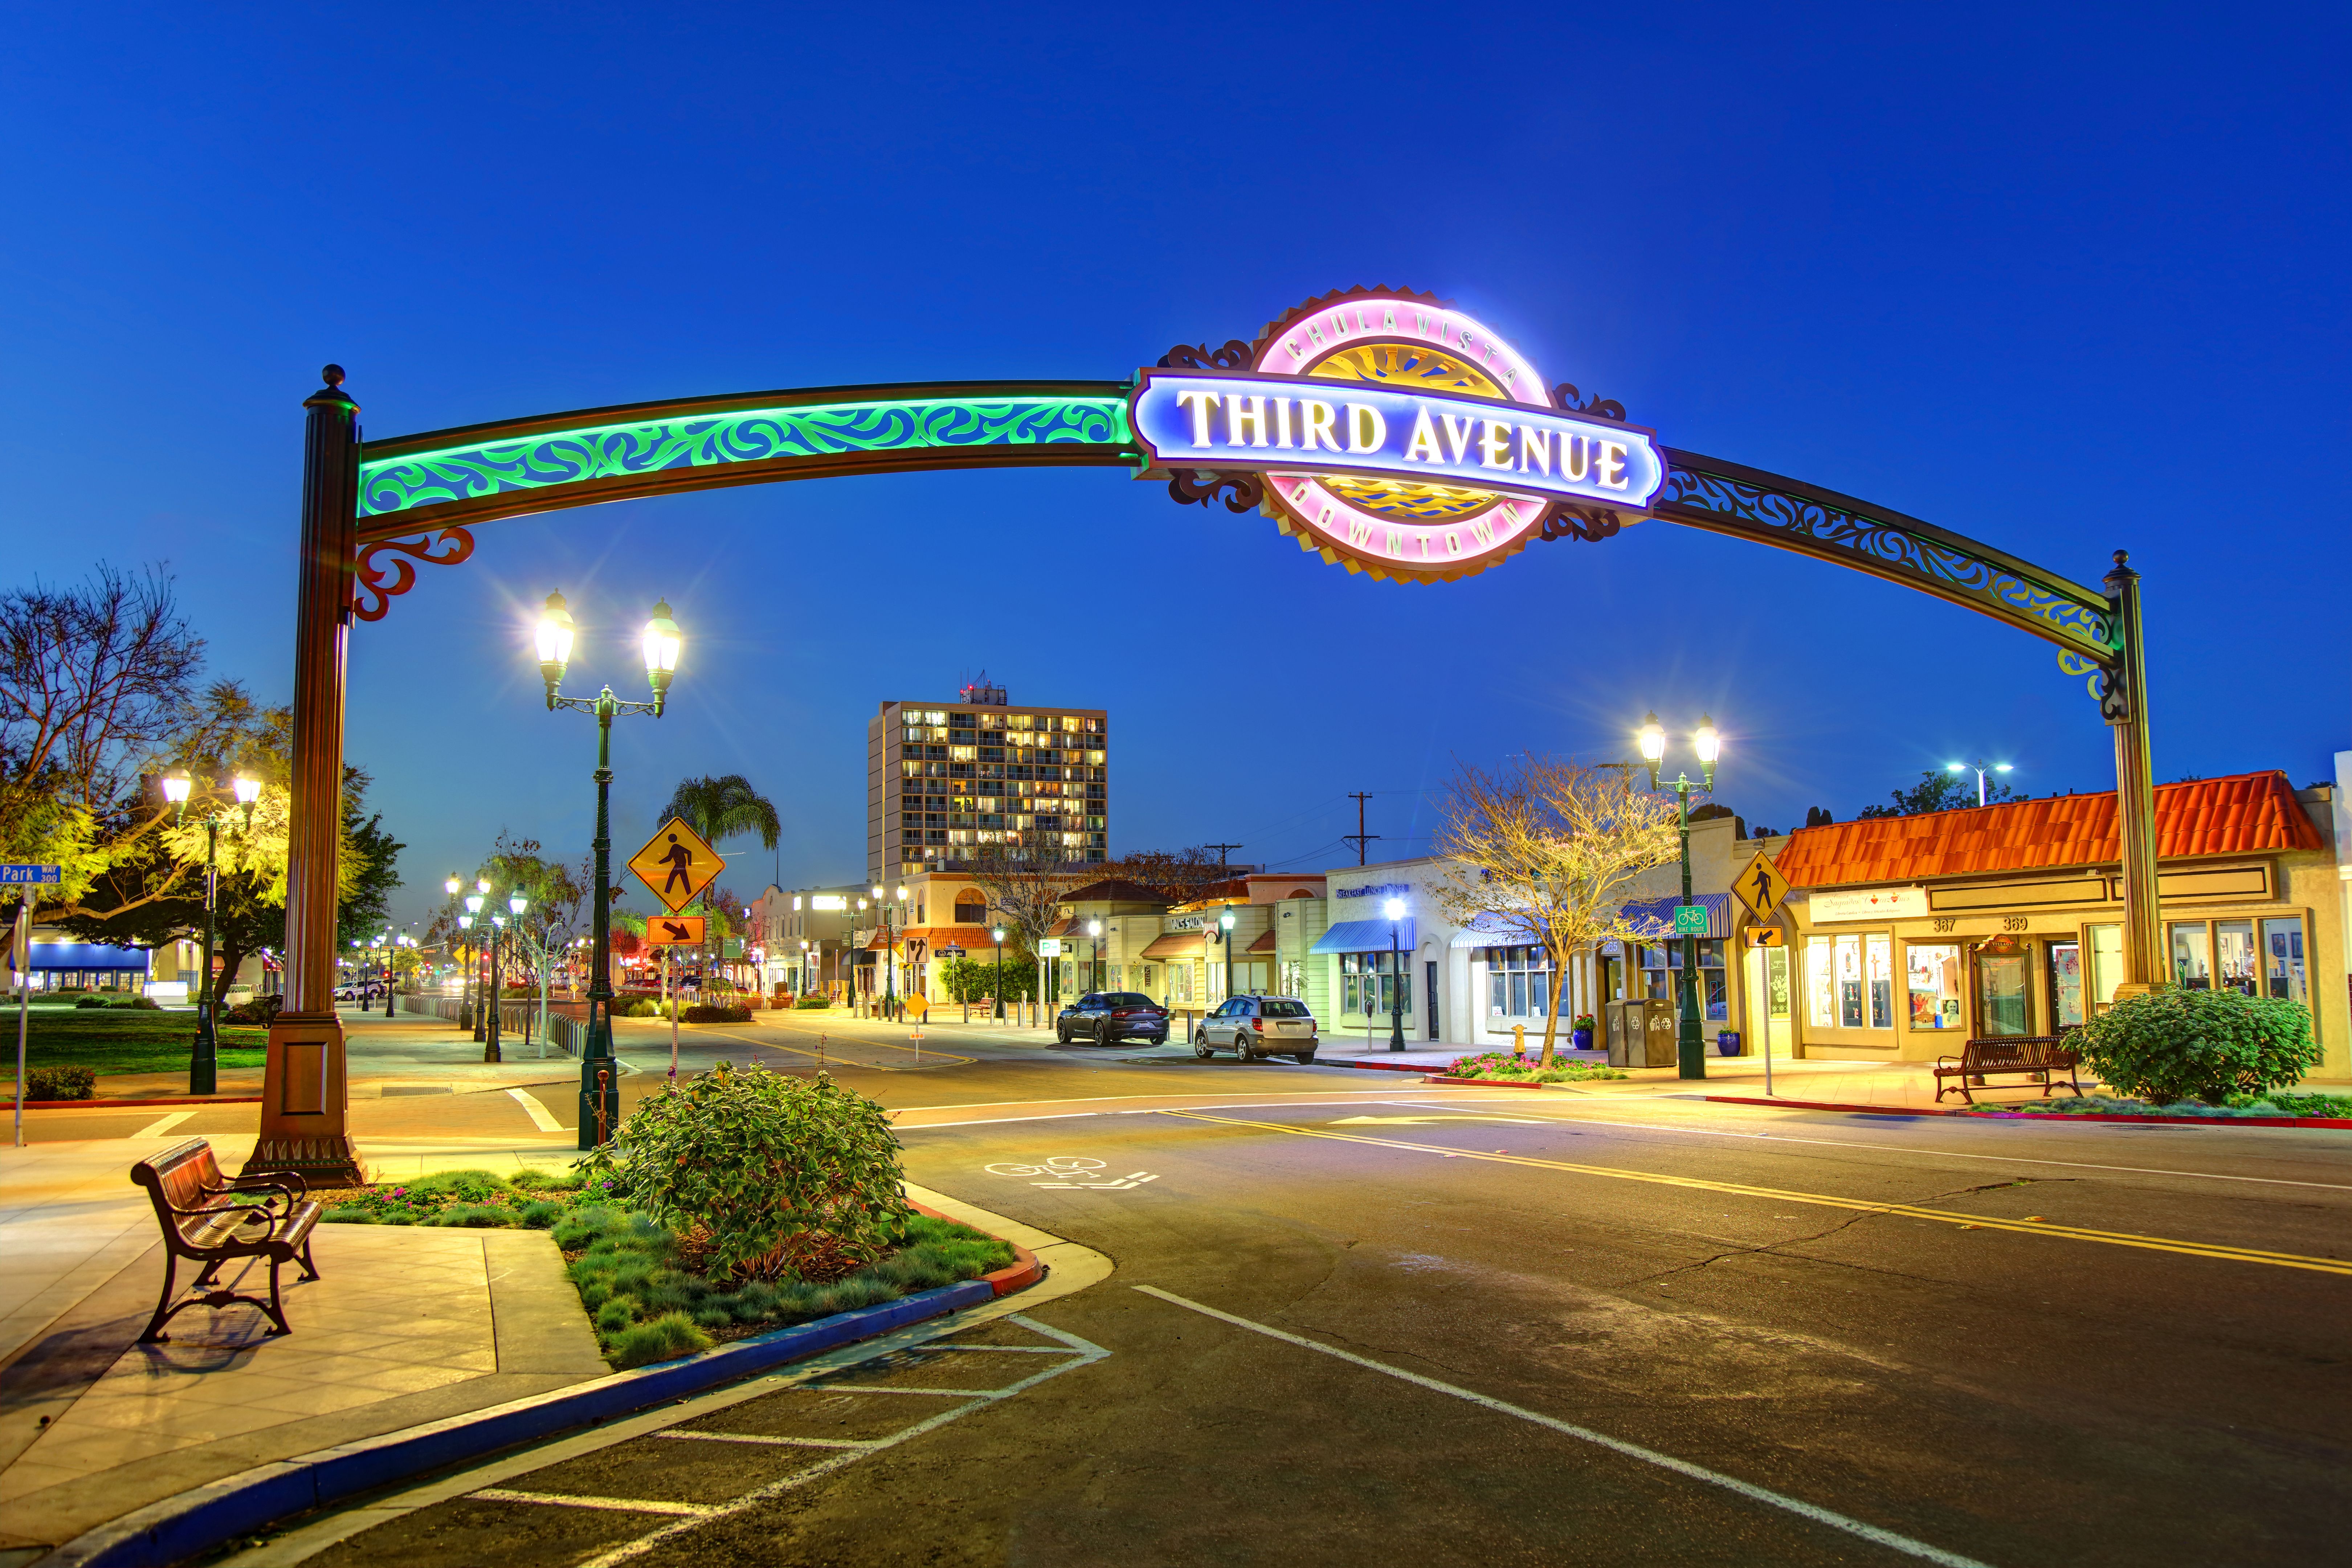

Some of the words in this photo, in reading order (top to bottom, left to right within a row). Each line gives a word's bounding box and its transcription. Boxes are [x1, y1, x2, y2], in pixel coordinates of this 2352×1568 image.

[1284, 309, 1398, 361] CHULA
[1416, 314, 1519, 389] VISTA
[1176, 390, 1387, 455] THIRD
[1402, 404, 1629, 492] AVENUE
[1289, 482, 1523, 557] DOWNTOWN
[3, 866, 33, 881] Park
[1824, 898, 1859, 908] Sagrados
[1185, 916, 1204, 929] SALON
[1934, 919, 1955, 932] 367
[2003, 917, 2028, 931] 369
[1042, 943, 1050, 952] P
[1604, 942, 1618, 952] 365
